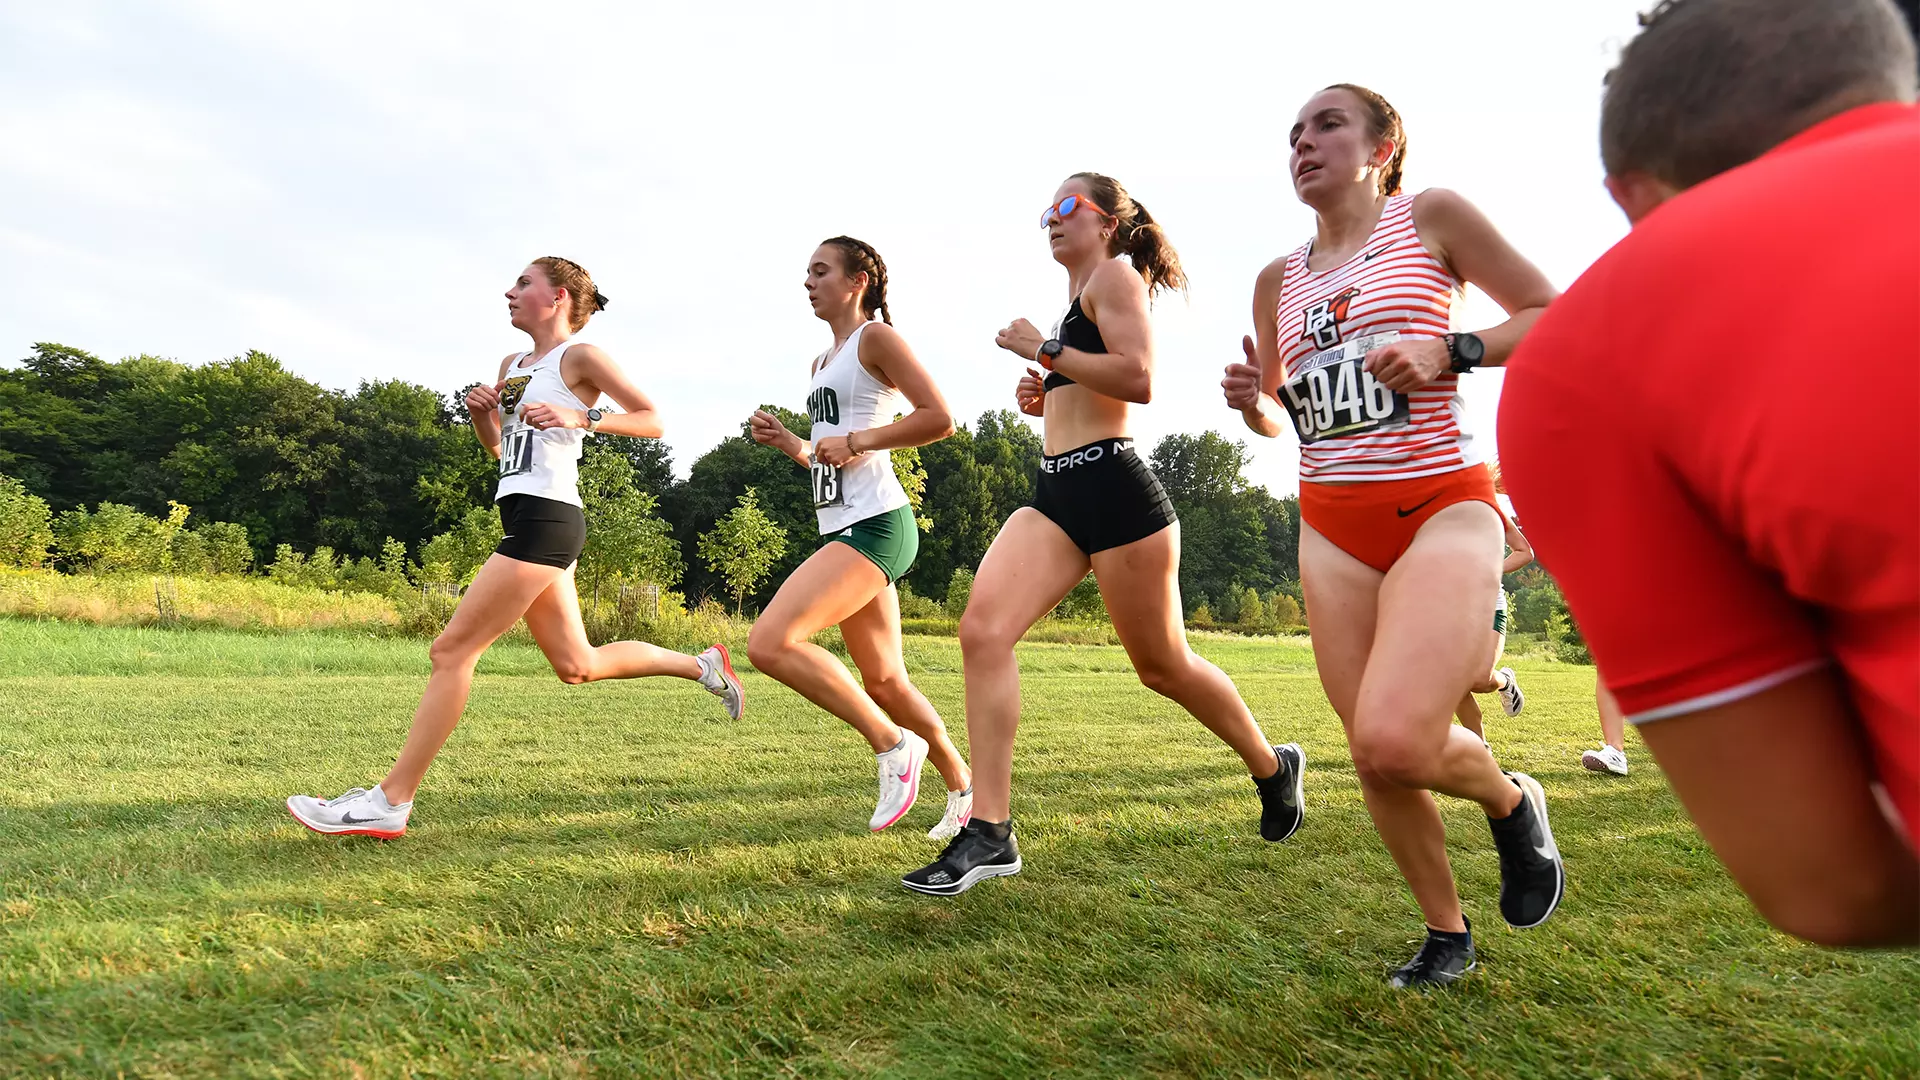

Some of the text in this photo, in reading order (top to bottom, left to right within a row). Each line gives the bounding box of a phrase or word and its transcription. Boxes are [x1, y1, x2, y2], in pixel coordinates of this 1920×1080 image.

[1285, 360, 1394, 436] 5946
[1057, 446, 1103, 473] PRO
[811, 462, 836, 503] 73
